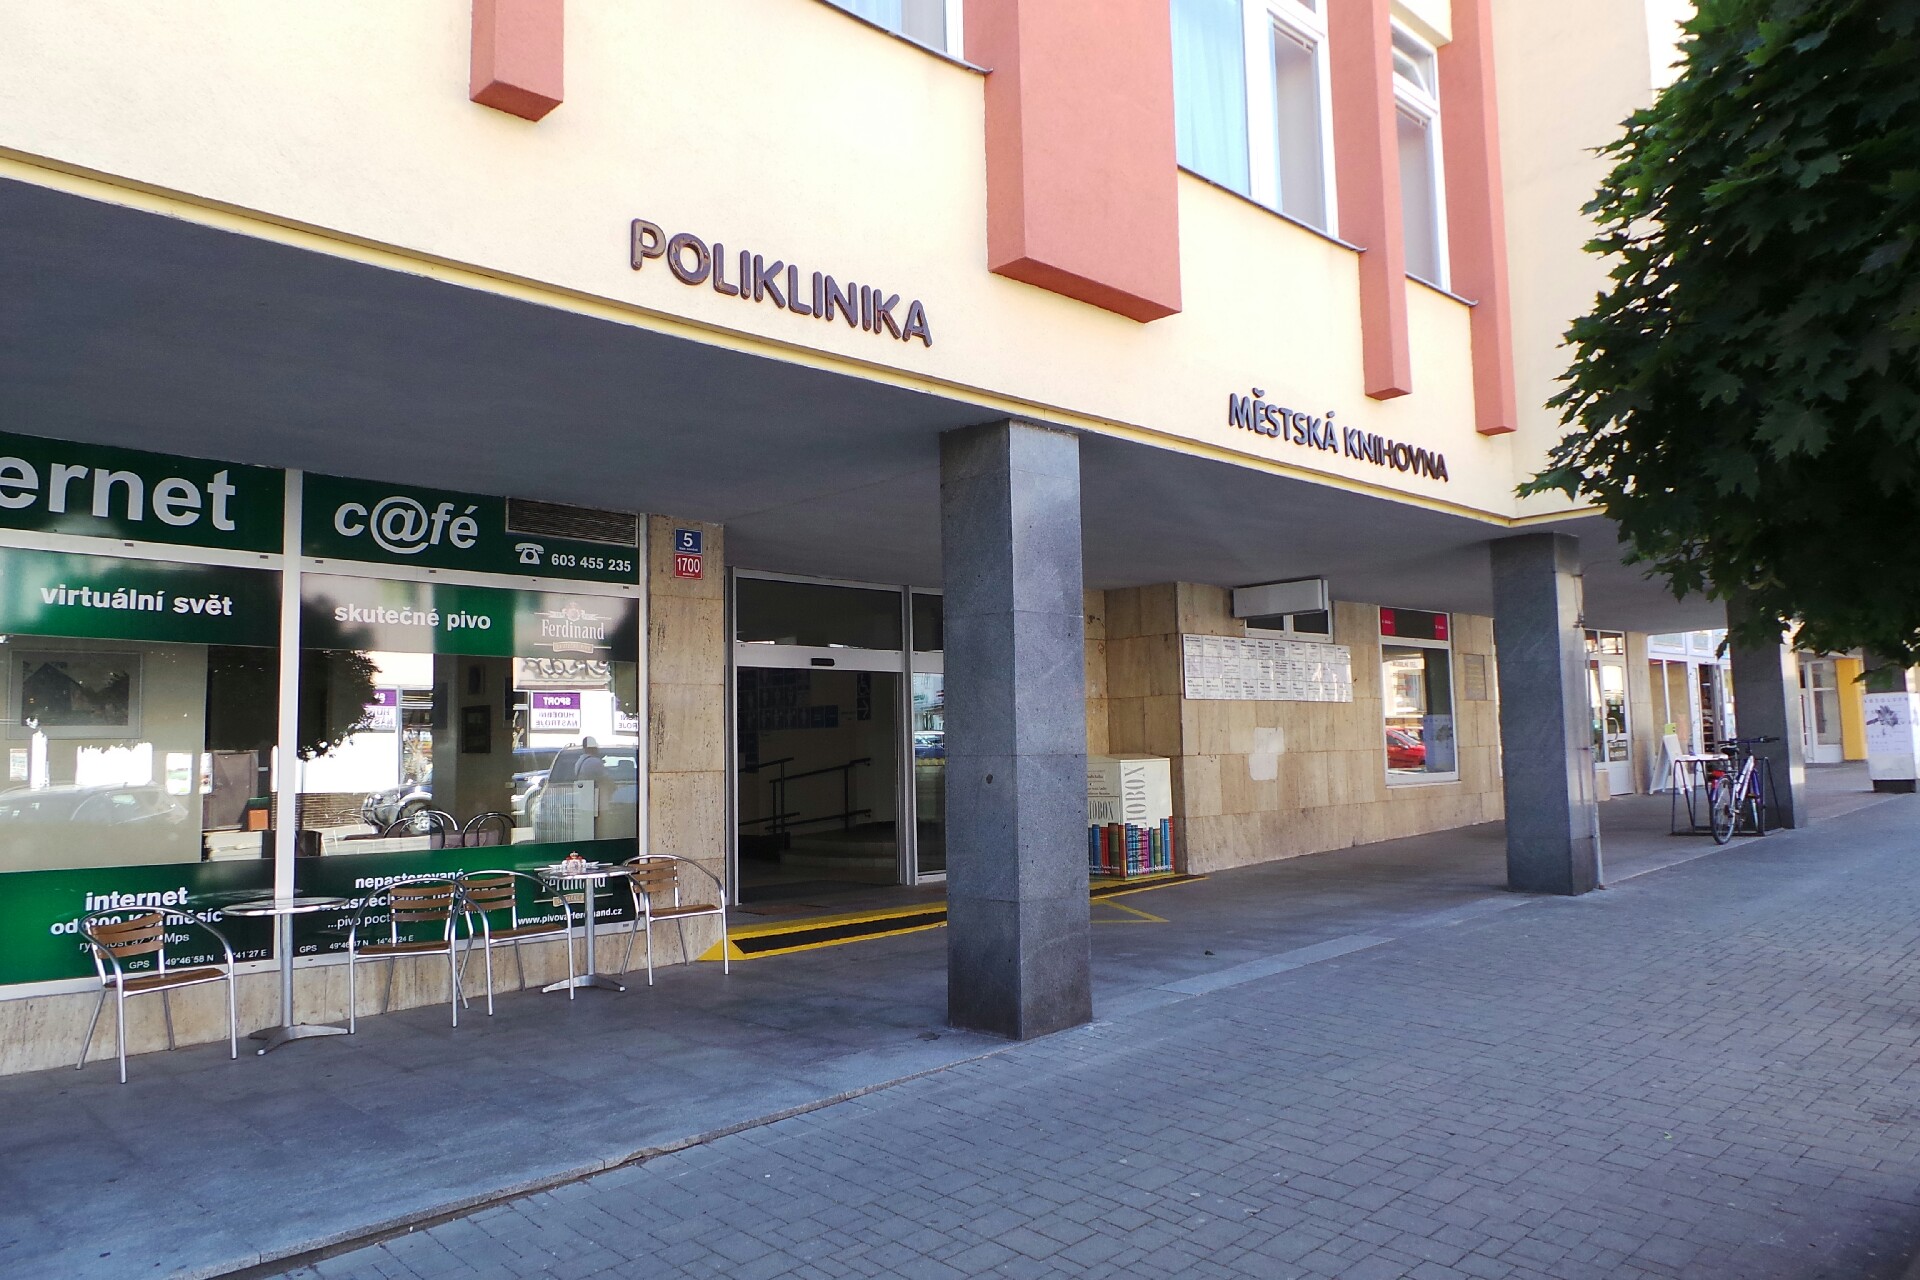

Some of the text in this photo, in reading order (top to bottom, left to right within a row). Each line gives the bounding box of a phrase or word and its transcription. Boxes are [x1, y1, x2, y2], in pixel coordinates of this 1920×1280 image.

[630, 218, 933, 347] POLIKLINIKA
[1229, 387, 1449, 482] MĚSTSKÁ KNIHOVNA
[0, 456, 236, 531] ernet
[334, 495, 479, 554] c@fé
[683, 532, 693, 547] 5
[551, 553, 631, 572] 603 455 235
[677, 557, 700, 573] 1700
[40, 584, 233, 616] virtuální svět
[334, 603, 491, 630] skutečné pivo
[541, 619, 605, 640] Ferdinand
[85, 886, 188, 912] internet
[50, 918, 78, 935] od
[129, 960, 150, 969] GPS
[261, 949, 267, 957] E
[299, 945, 318, 953] GPS
